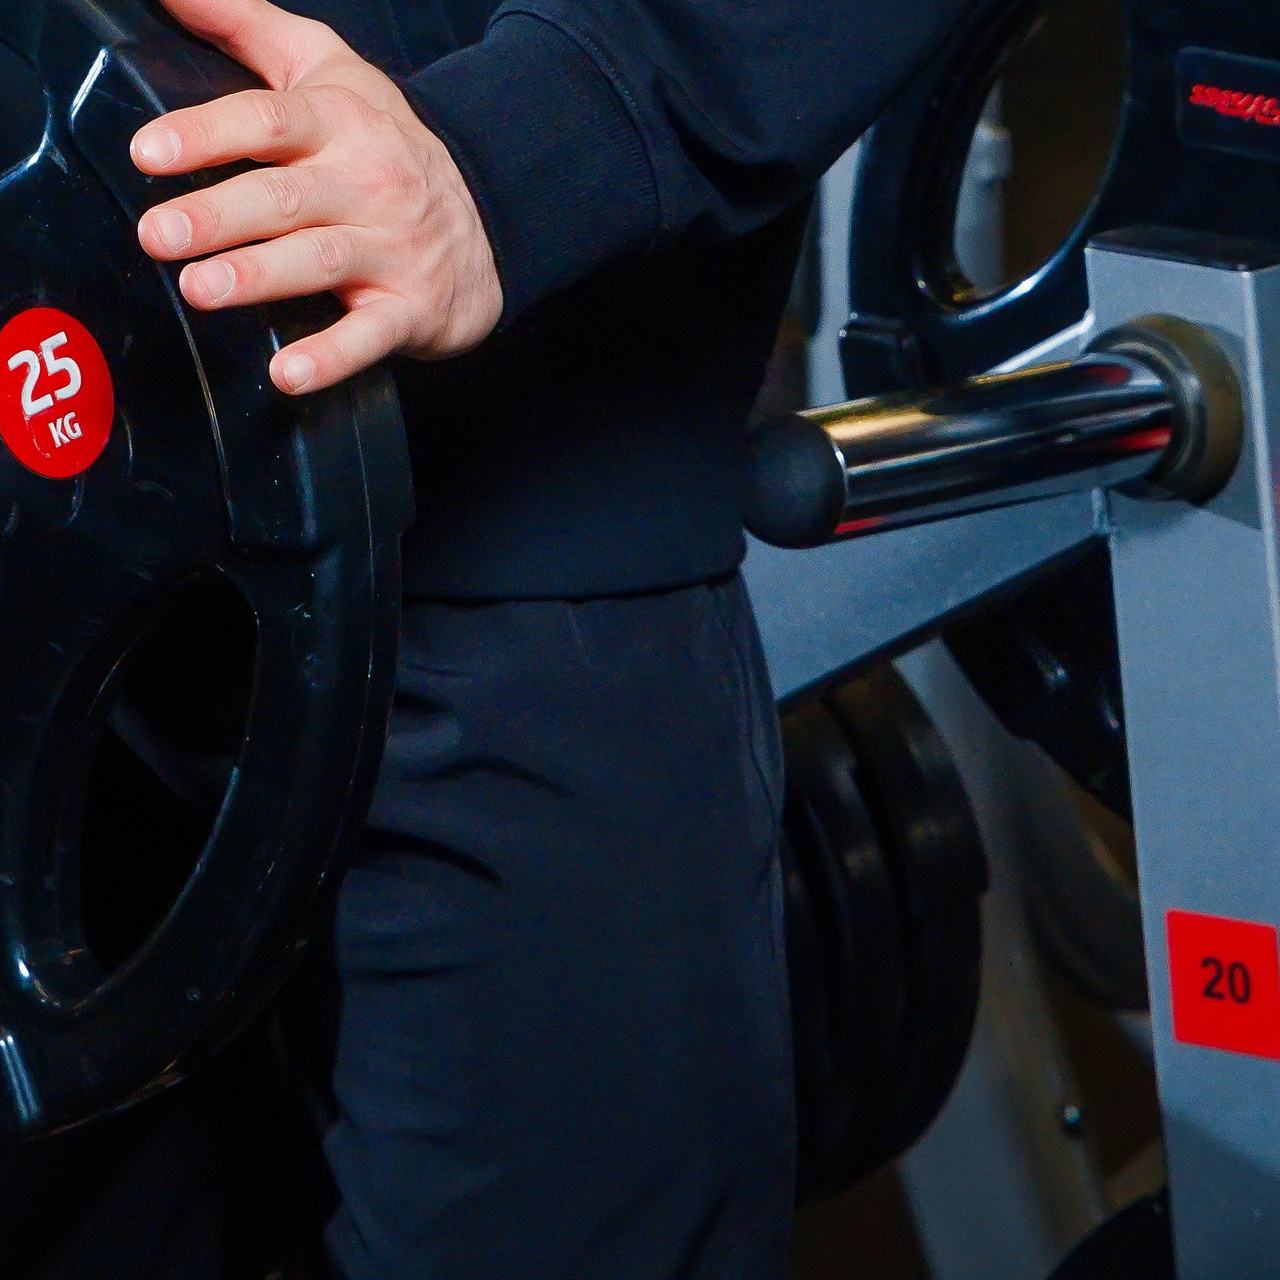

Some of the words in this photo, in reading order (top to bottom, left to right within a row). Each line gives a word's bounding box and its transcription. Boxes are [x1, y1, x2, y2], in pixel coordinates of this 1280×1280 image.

[7, 330, 82, 417] 25
[48, 411, 83, 449] KG
[1201, 956, 1251, 1004] 20
